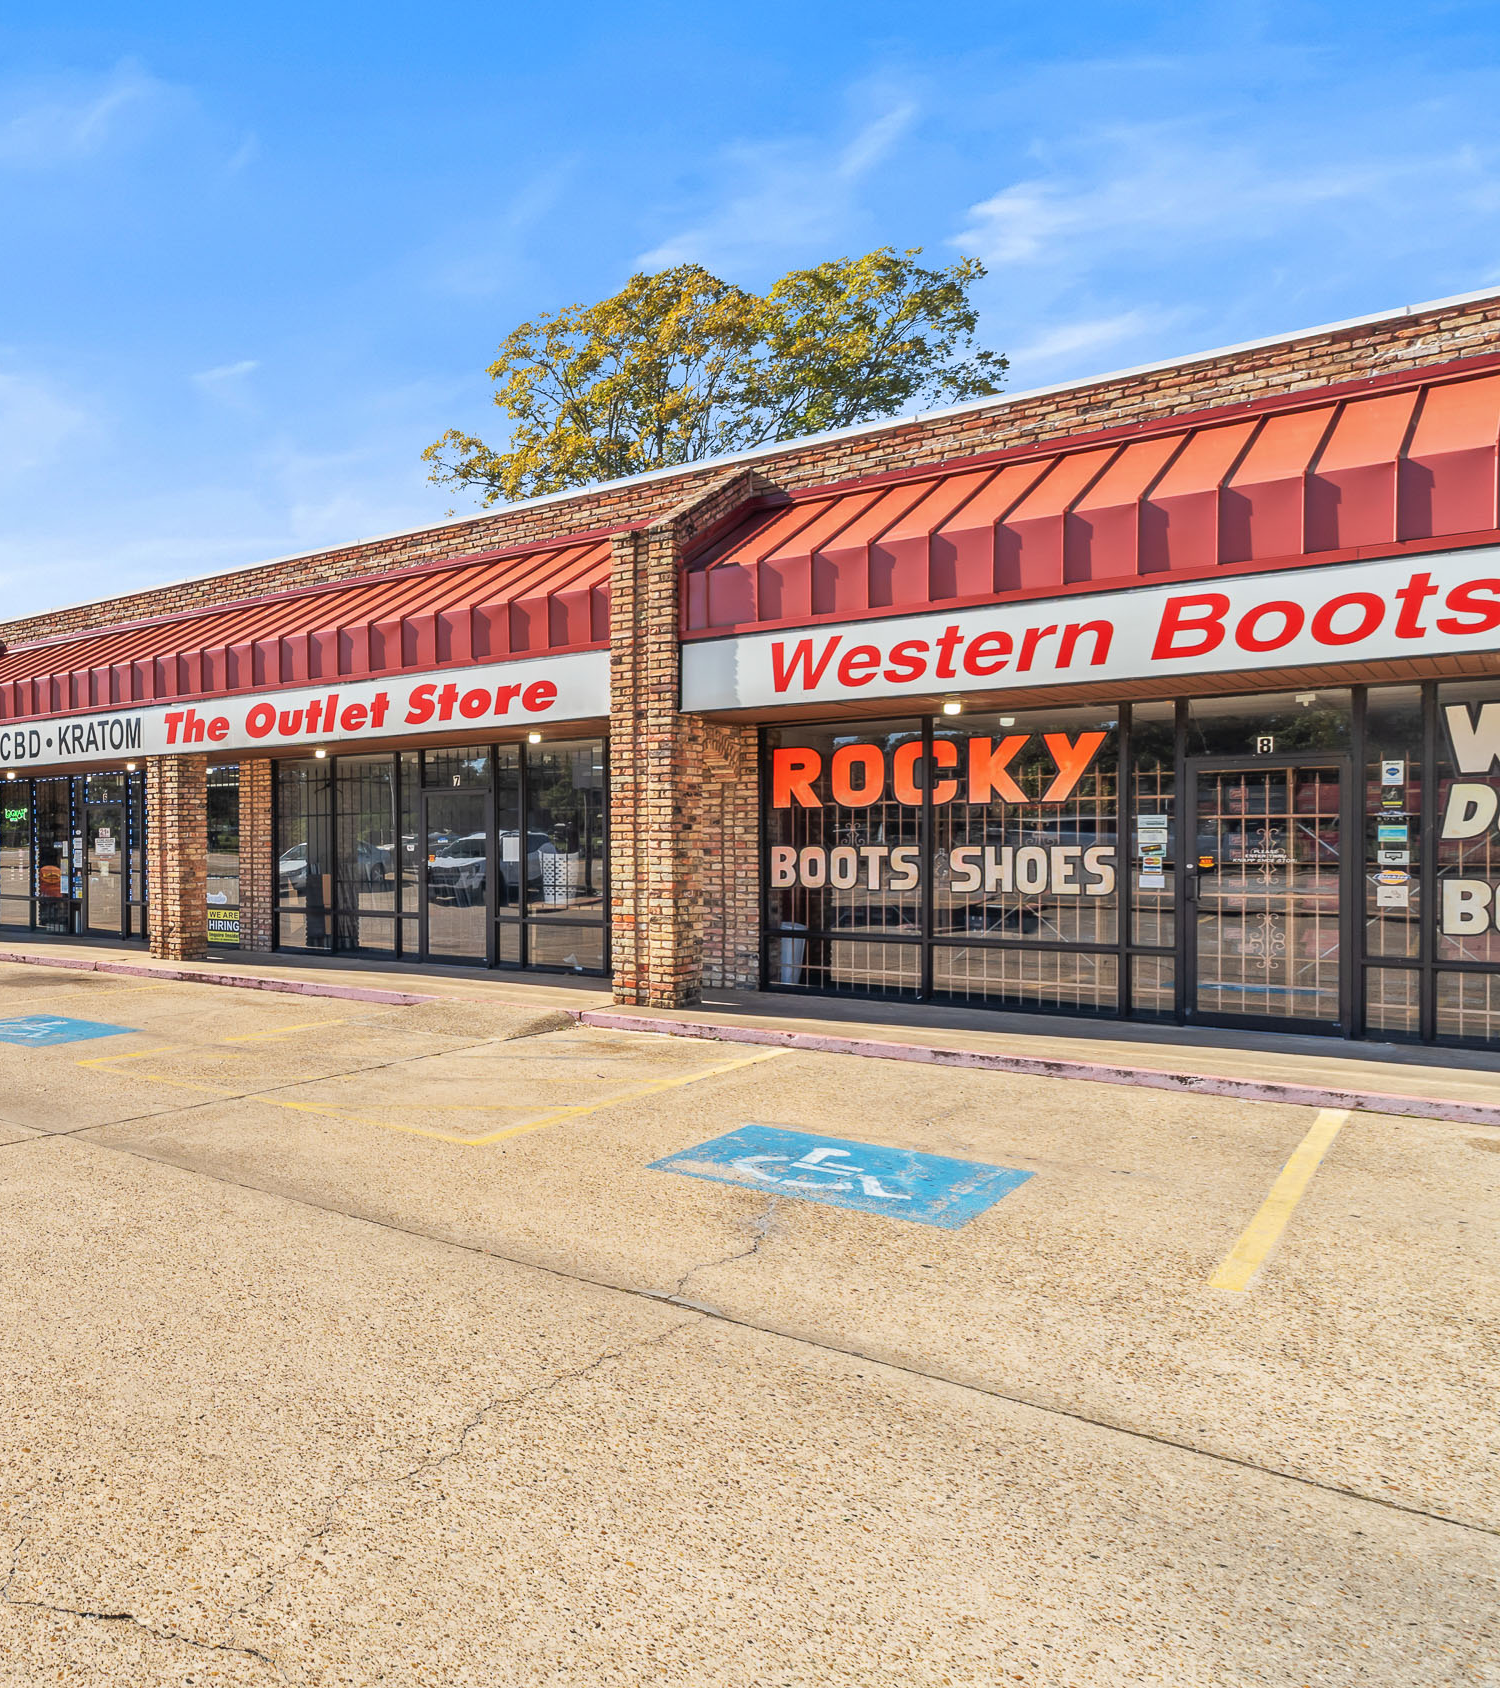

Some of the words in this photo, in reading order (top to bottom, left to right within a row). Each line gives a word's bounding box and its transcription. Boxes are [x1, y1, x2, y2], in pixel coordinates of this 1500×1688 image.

[769, 618, 1116, 694] Western
[1150, 571, 1500, 661] Boots
[0, 729, 41, 761] CBD
[58, 717, 142, 755] KRATOM
[164, 708, 230, 745] The
[245, 692, 391, 739] Outlet
[403, 679, 559, 725] Store
[772, 731, 1109, 809] ROCKY
[1259, 738, 1272, 753] 8
[1441, 783, 1500, 839] D
[771, 846, 921, 892] BOOTS
[950, 845, 1117, 896] SHOES
[208, 920, 240, 931] HIRING
[1442, 879, 1500, 935] B
